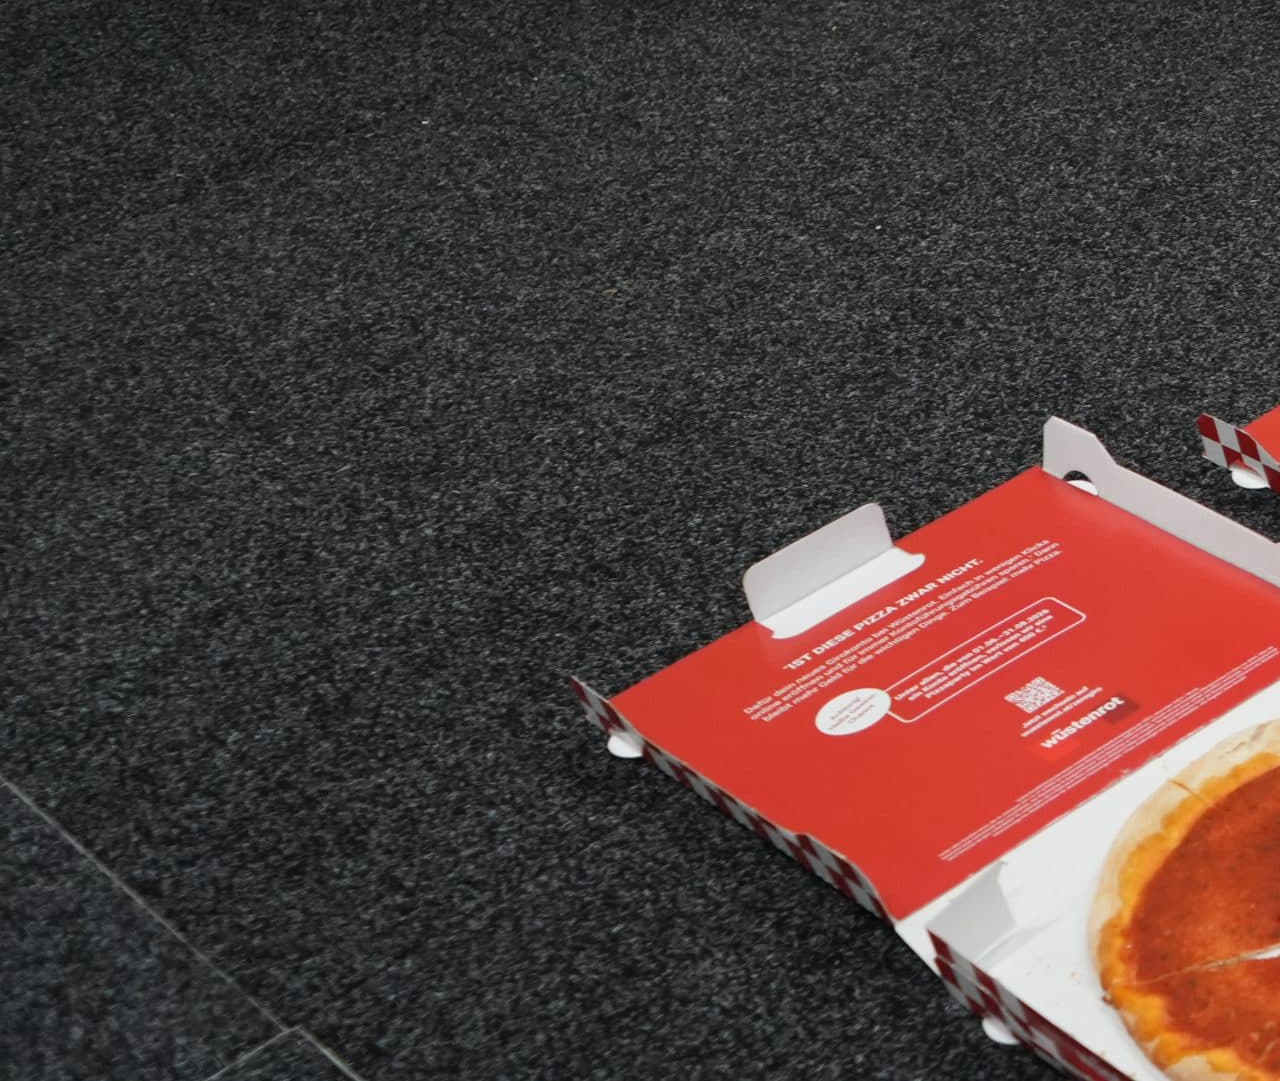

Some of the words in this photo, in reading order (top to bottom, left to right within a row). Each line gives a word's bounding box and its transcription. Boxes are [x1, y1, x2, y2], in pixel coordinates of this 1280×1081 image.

[744, 696, 772, 714] Dafür
[774, 683, 796, 696] dein
[796, 666, 826, 683] neues
[938, 581, 974, 600] Einfach
[984, 555, 1022, 575] wenigen
[1021, 540, 1049, 555] Klicks
[762, 704, 792, 721] bleibt
[793, 688, 818, 704] mehr
[819, 673, 842, 687] Geld
[874, 628, 920, 654] wichtigen
[918, 612, 948, 628] Dinge.
[949, 598, 972, 611] Zum
[1010, 564, 1034, 577] mehr
[813, 629, 854, 654] DIESE
[854, 607, 897, 630] PIZZA
[896, 583, 938, 606] ZWAR
[937, 559, 982, 583] NICHT.
[751, 701, 781, 720] online
[782, 676, 824, 701] eröffnen
[824, 663, 844, 675] und
[858, 636, 889, 654] immer
